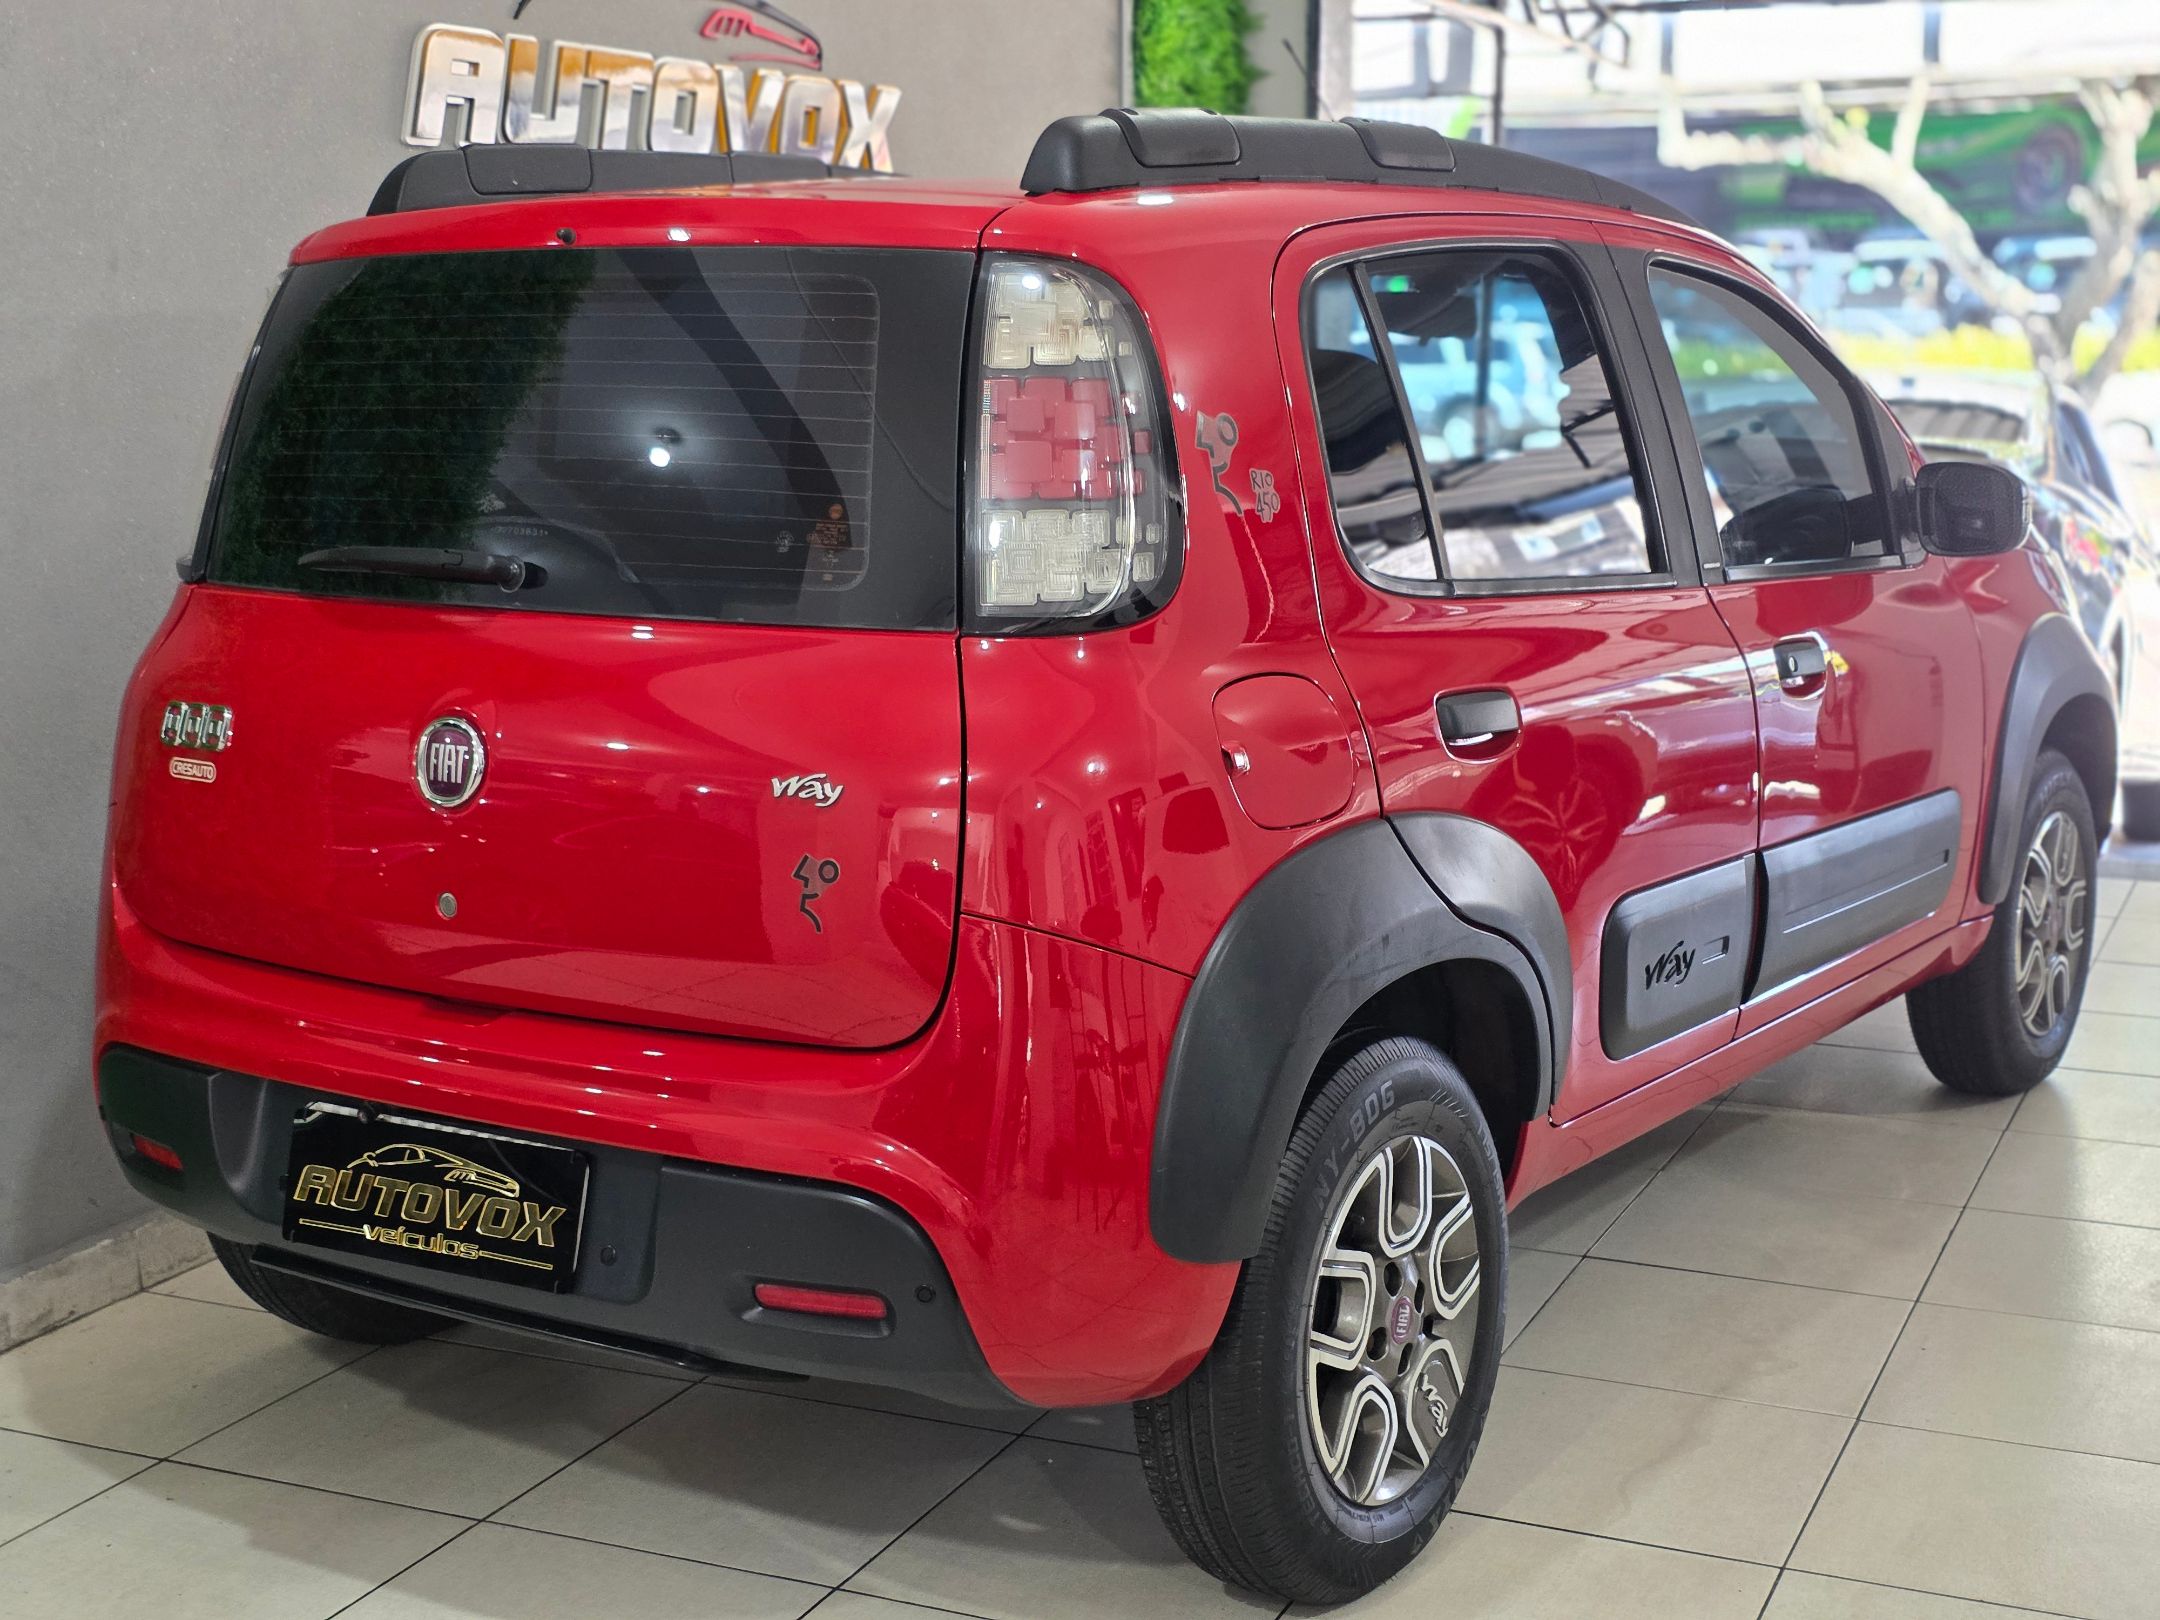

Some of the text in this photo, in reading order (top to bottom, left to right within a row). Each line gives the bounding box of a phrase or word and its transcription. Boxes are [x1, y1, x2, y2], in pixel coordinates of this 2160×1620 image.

[401, 22, 902, 173] AUTOVOX
[1250, 470, 1273, 490] RIO
[1256, 492, 1281, 521] 450
[172, 761, 214, 780] CRESAUTO
[428, 742, 469, 785] FIAT
[771, 773, 844, 807] Way
[1644, 940, 1696, 990] Way
[293, 1164, 567, 1248] AUTOVOX
[362, 1223, 480, 1260] veículos
